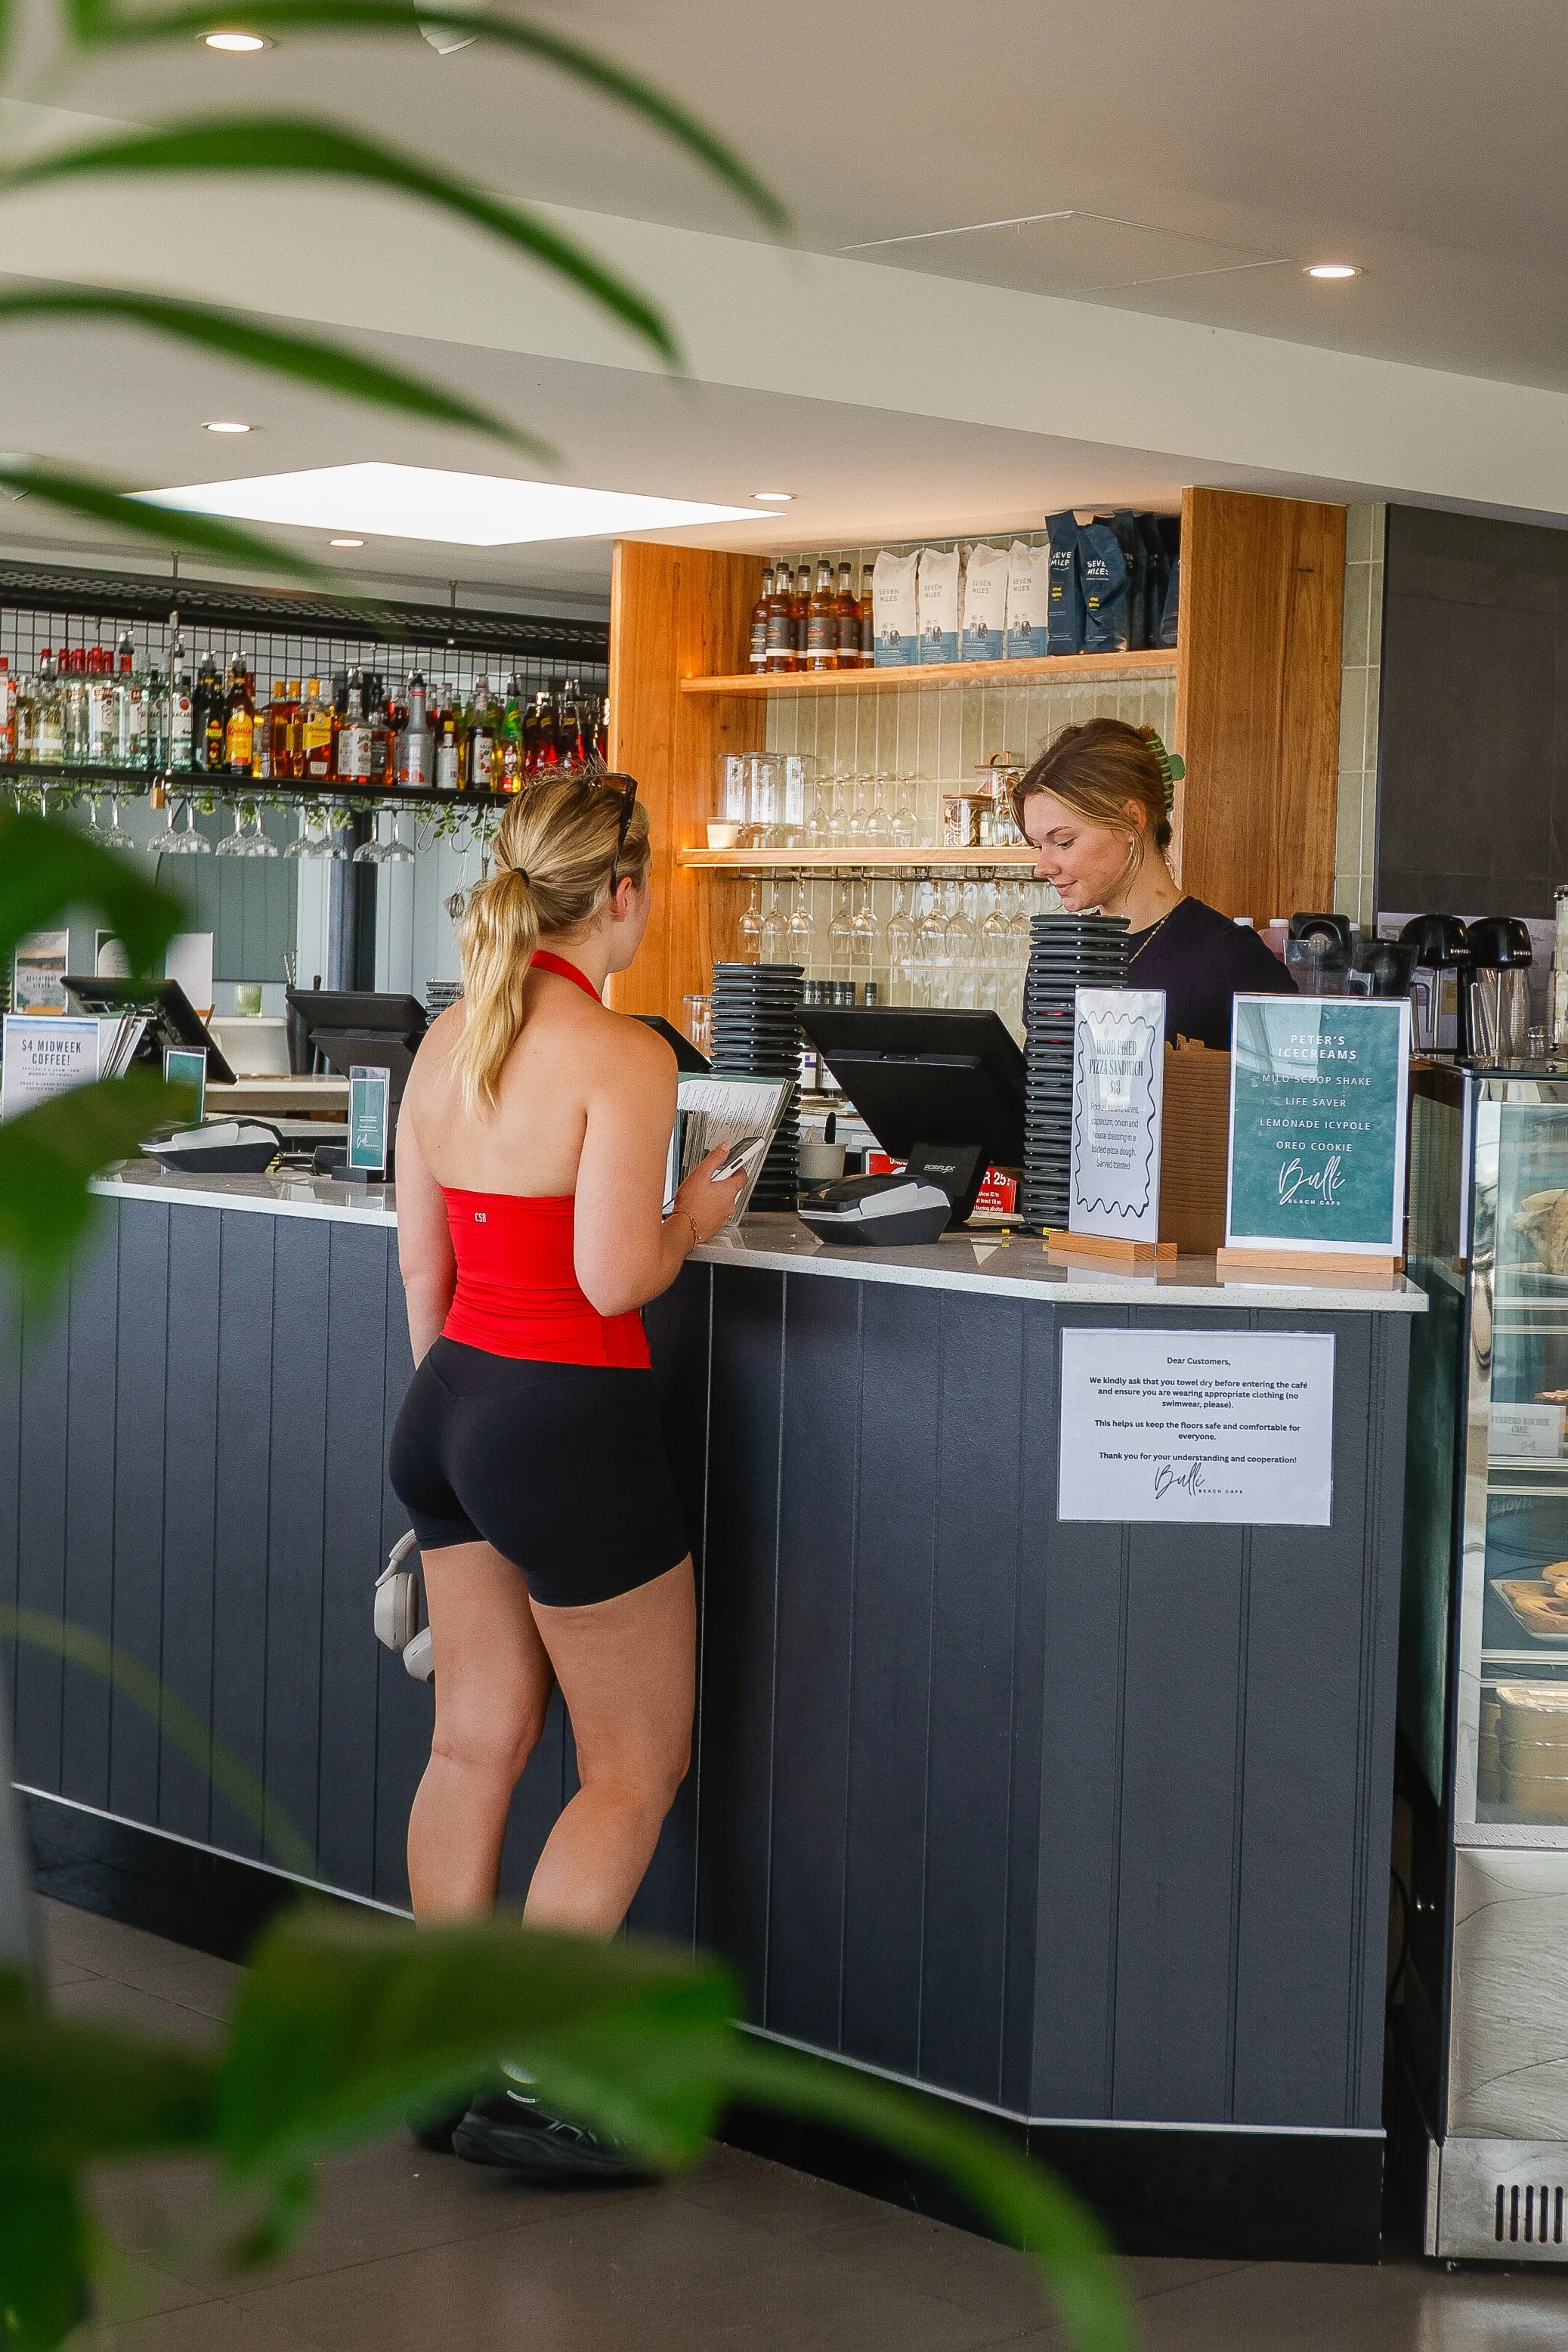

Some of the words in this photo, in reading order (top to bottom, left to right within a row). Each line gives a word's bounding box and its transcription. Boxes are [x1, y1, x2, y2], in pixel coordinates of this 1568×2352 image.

[1291, 1035, 1345, 1045] PETER'S
[22, 1039, 32, 1051] $4
[38, 1040, 82, 1054] MIDWEEK
[1096, 1040, 1115, 1055] WOOD
[1118, 1041, 1137, 1056] FIRED
[32, 1054, 70, 1066] COFFEE!
[1279, 1048, 1357, 1060] ICECREAMS
[1089, 1059, 1108, 1075] PIZZA
[1109, 1060, 1143, 1076] SANDWICH
[1262, 1074, 1290, 1083] MILO
[1294, 1075, 1331, 1084] SCOOP
[1336, 1076, 1372, 1086] SHAKE
[1313, 1098, 1347, 1107] SAVER
[1091, 1118, 1113, 1128] capsicum,
[1128, 1119, 1139, 1128] and
[1260, 1119, 1320, 1128] LEMONADE
[1325, 1121, 1371, 1131] ICYPOLE
[1093, 1131, 1107, 1140] house
[1107, 1132, 1127, 1143] dressing
[1091, 1144, 1106, 1154] folded
[1107, 1147, 1118, 1155] pizza
[1120, 1147, 1137, 1158] dough.
[1276, 1140, 1306, 1150] OREO
[1311, 1143, 1353, 1152] COOKIE
[1096, 1159, 1113, 1168] Served
[1113, 1161, 1130, 1170] toasted
[1279, 1156, 1346, 1205] Bulli
[1187, 1357, 1231, 1366] Customers,
[1103, 1377, 1127, 1386] kindly
[1200, 1379, 1213, 1388] dry
[1214, 1379, 1241, 1388] before
[1242, 1381, 1275, 1390] entering
[1172, 1390, 1203, 1398] wearing
[1204, 1391, 1251, 1399] appropriate
[1251, 1391, 1285, 1400] clothing
[1285, 1391, 1299, 1400] (no
[1161, 1400, 1202, 1409] swimwear,
[1203, 1401, 1234, 1410] please).
[1112, 1420, 1133, 1428] helps
[1146, 1421, 1164, 1429] keep
[1239, 1423, 1288, 1431] comfortable
[1173, 1453, 1229, 1463] understanding
[1247, 1456, 1297, 1464] cooperation!
